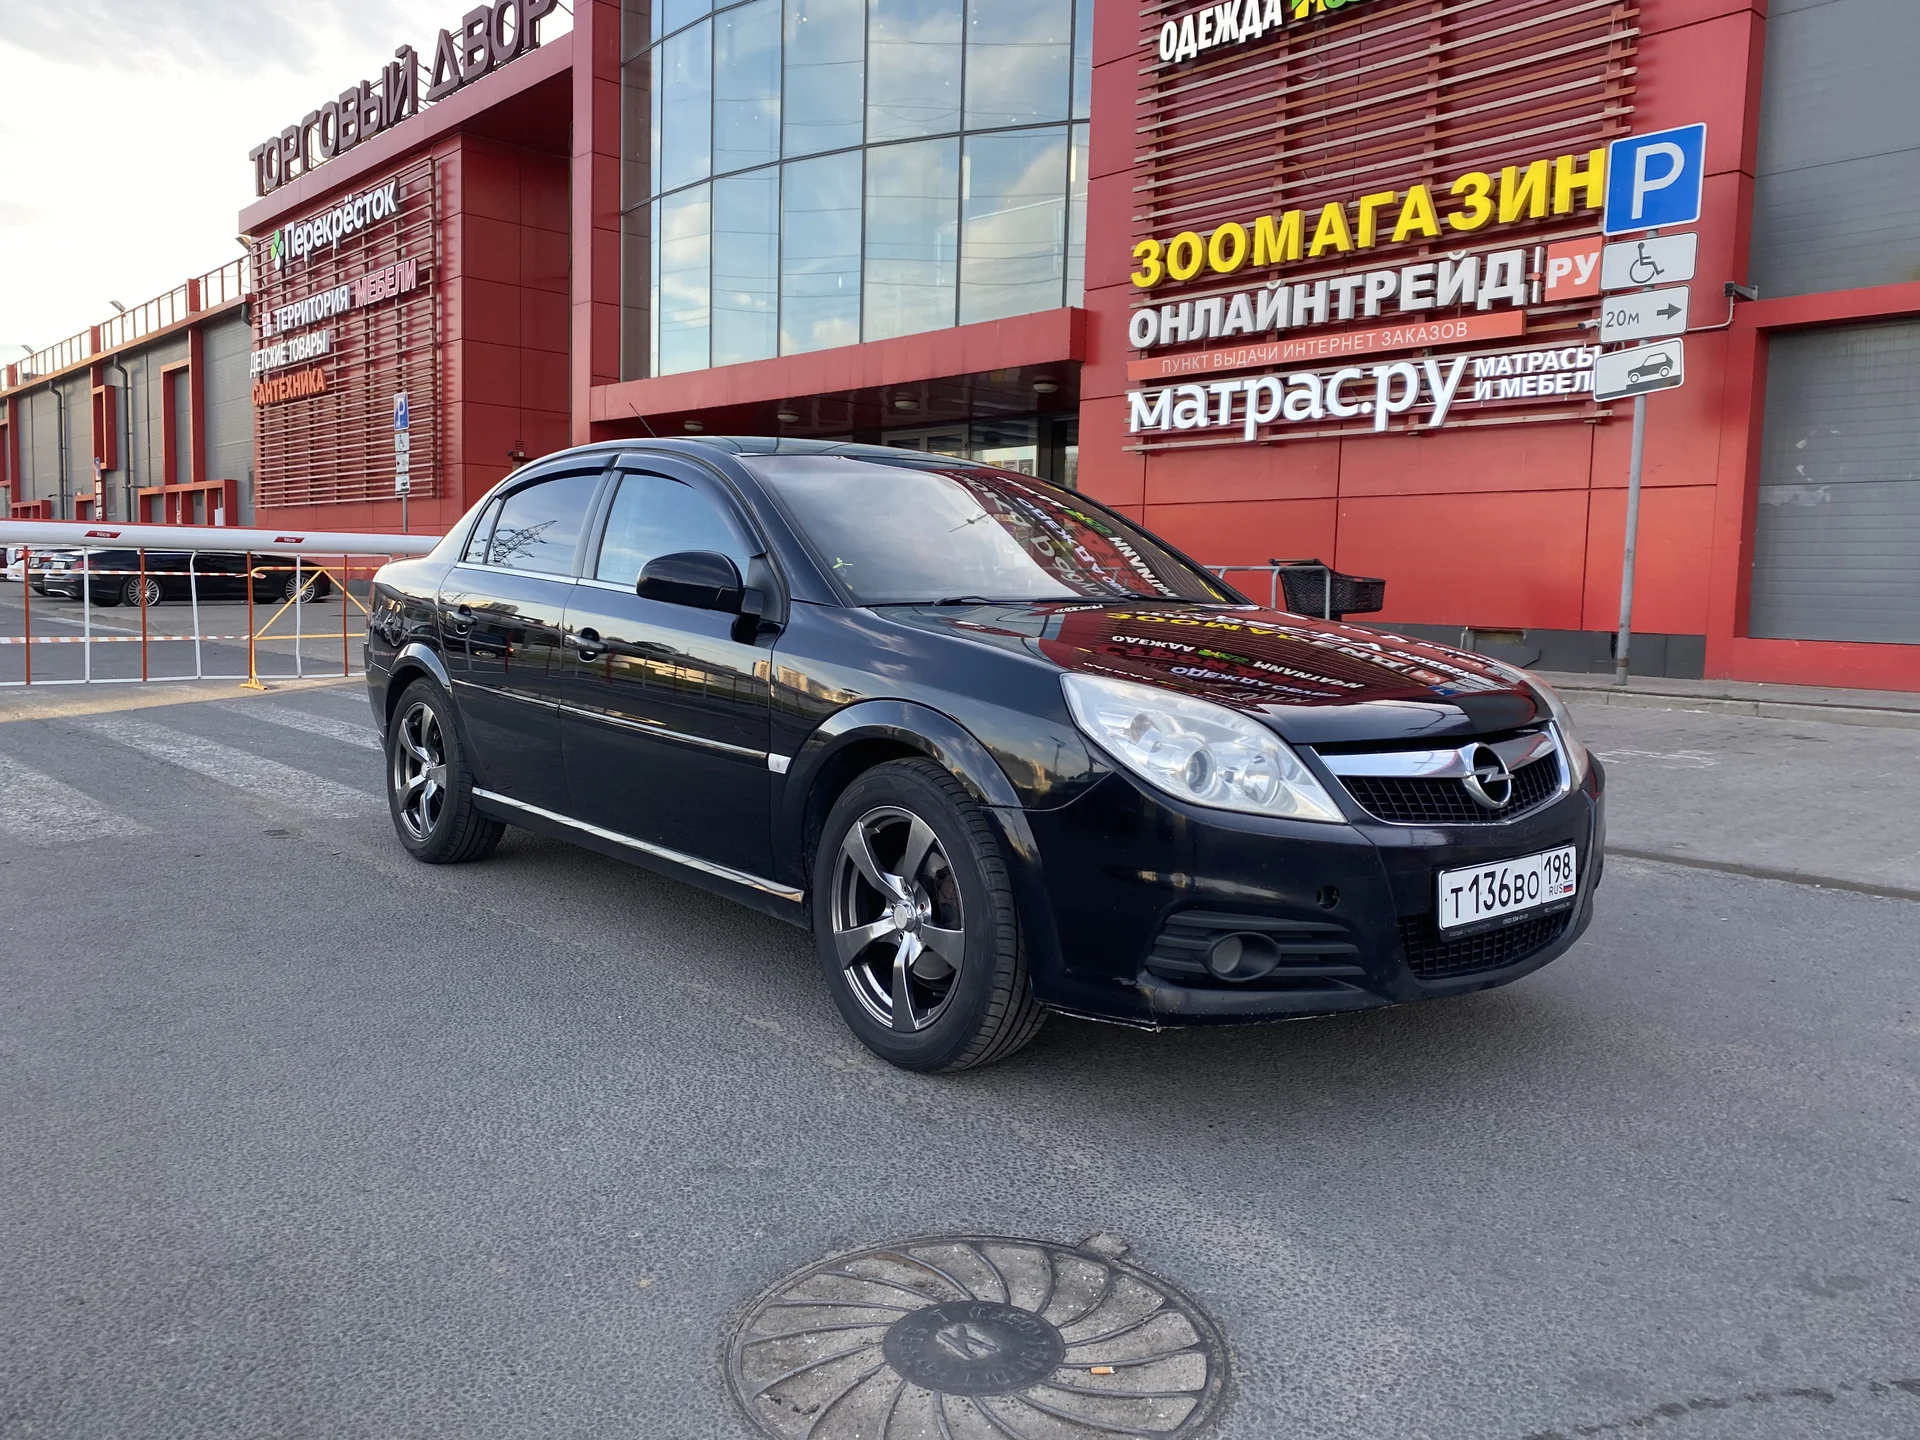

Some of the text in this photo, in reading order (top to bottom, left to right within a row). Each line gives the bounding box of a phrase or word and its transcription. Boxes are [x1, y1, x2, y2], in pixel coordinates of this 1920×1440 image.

[1159, 0, 1283, 63] ОДЕЖДА
[249, 0, 558, 197] ТОРГОВЫЙ ДВОР
[284, 176, 400, 262] Перекрёсток
[1131, 147, 1605, 289] ЗООМАГАЗИН
[273, 258, 418, 333] ТЕРРИТОРИЯ МЕБЕЛИ
[249, 328, 330, 379] ДЕТСКИЕ ТОВАРЫ
[1161, 321, 1468, 373] ПУНКТ ВЫДАЧИ ИНТЕРНЕТ ЗАКАЗОВ
[1474, 345, 1602, 378] МАТРАСЫ
[252, 367, 327, 406] САНТЕХНИКА
[1127, 355, 1469, 441] матрас.ру
[1474, 371, 1595, 400] И МЕБЕЛ
[1544, 852, 1571, 885] 198
[1549, 883, 1563, 896] RUS
